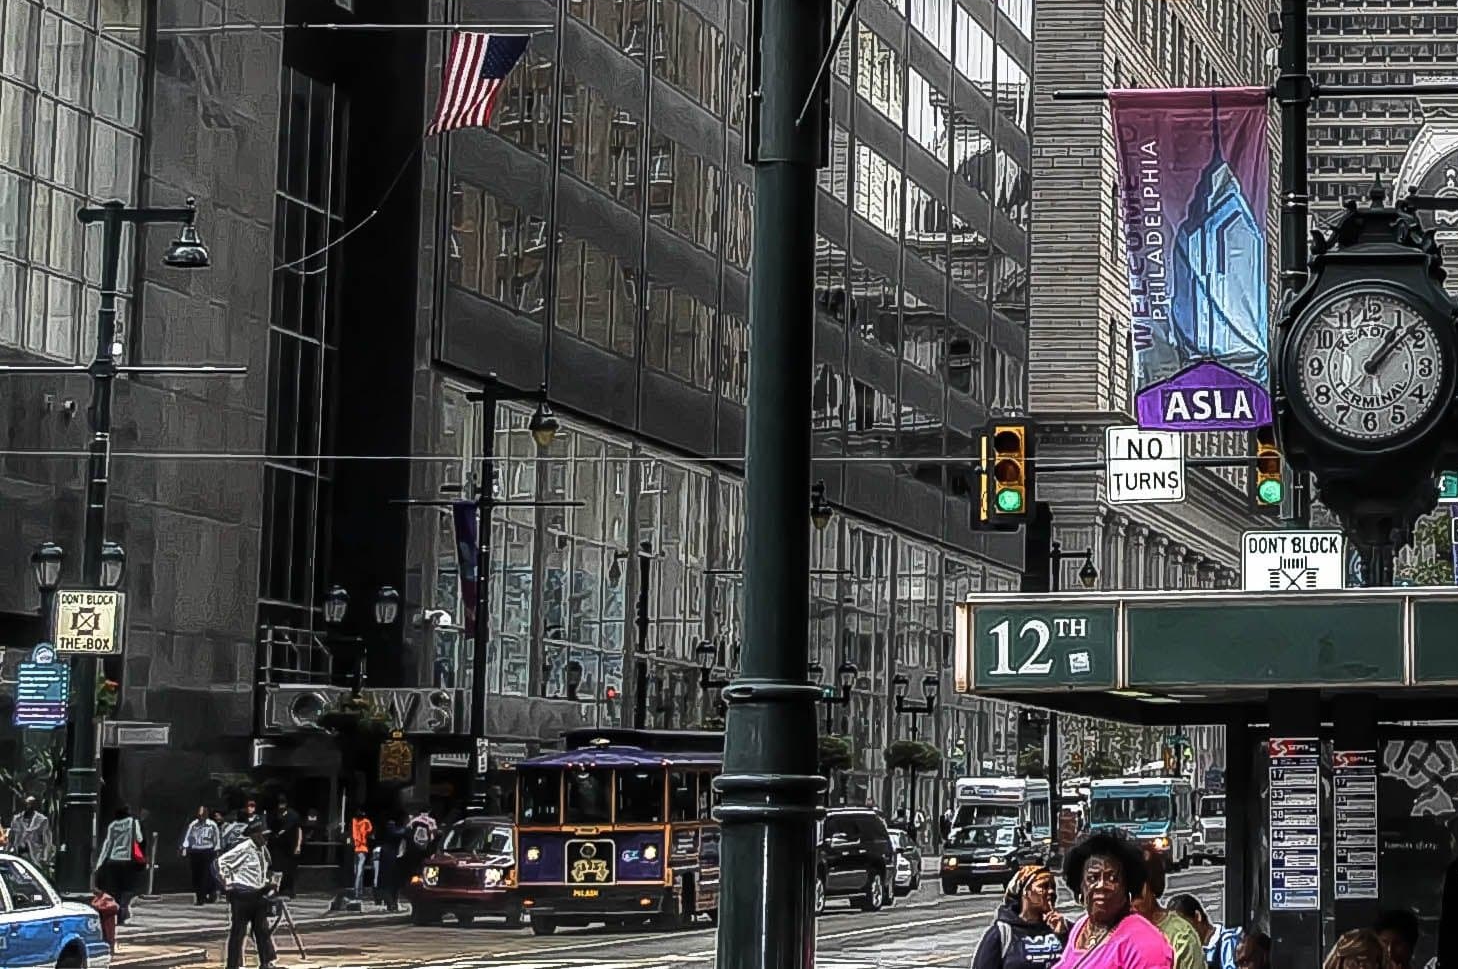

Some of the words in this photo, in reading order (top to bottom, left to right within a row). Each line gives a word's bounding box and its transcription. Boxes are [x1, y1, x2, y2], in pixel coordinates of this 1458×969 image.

[1140, 140, 1167, 321] PHILADELPHIA
[1337, 311, 1352, 329] 11
[1361, 302, 1382, 322] 12
[1395, 310, 1403, 329] 1
[1314, 329, 1334, 349] 10
[1412, 330, 1425, 349] 2
[1309, 357, 1323, 377] 9
[1418, 357, 1433, 377] 3
[1315, 384, 1331, 405] 8
[1335, 377, 1408, 408] TERMINAL
[1408, 384, 1430, 405] 4
[1165, 390, 1254, 421] ASLA
[1336, 405, 1350, 426] 7
[1391, 404, 1406, 424] 5
[1363, 411, 1377, 432] 6
[1127, 437, 1163, 460] NO
[1113, 471, 1179, 491] TURNS
[1291, 536, 1339, 554] BLOCK
[87, 594, 114, 605] BLOCK
[59, 637, 81, 649] THE
[87, 638, 110, 650] BOX
